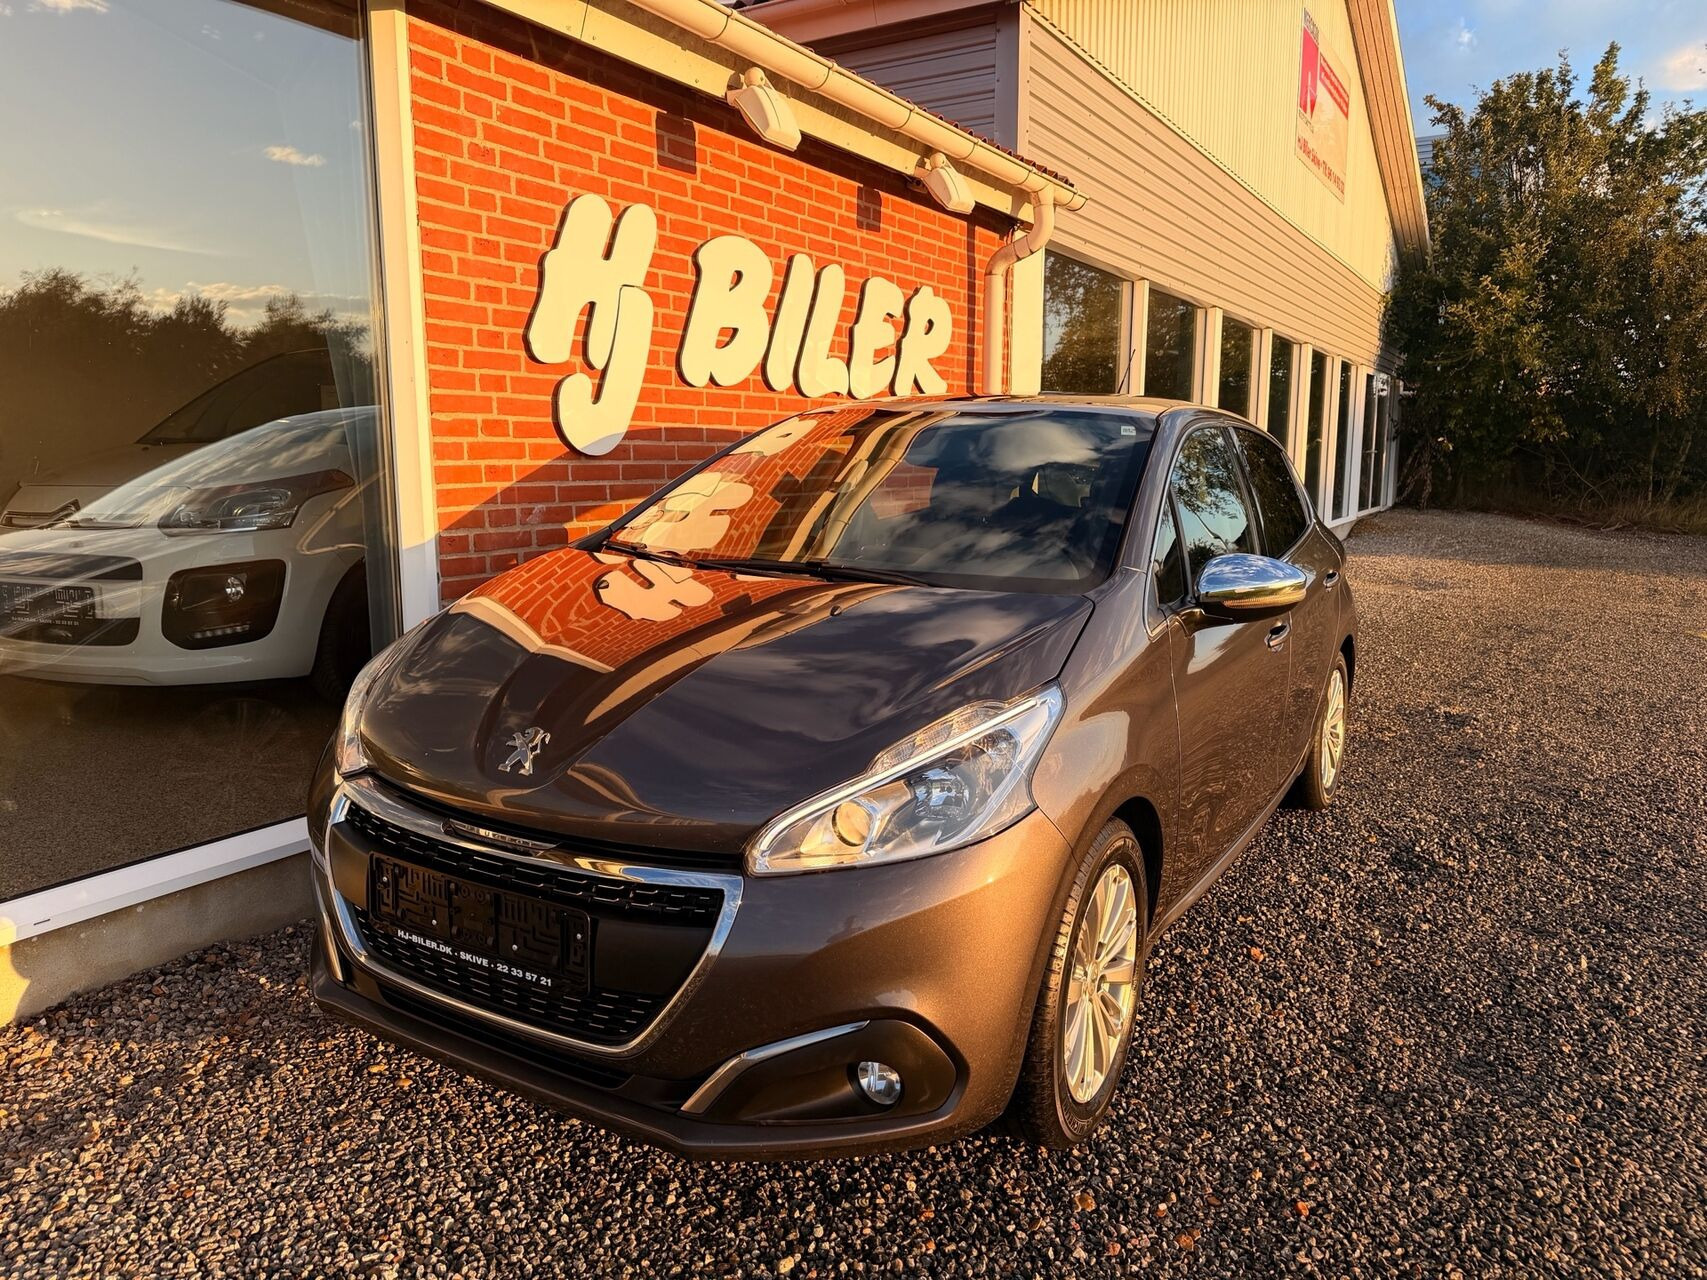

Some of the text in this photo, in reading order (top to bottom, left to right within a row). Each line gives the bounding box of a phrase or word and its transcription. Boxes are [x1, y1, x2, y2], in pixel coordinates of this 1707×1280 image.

[523, 193, 952, 456] HJ BILER
[398, 929, 552, 987] HJ-BILER.DK SKIVE 22 33 57 21
